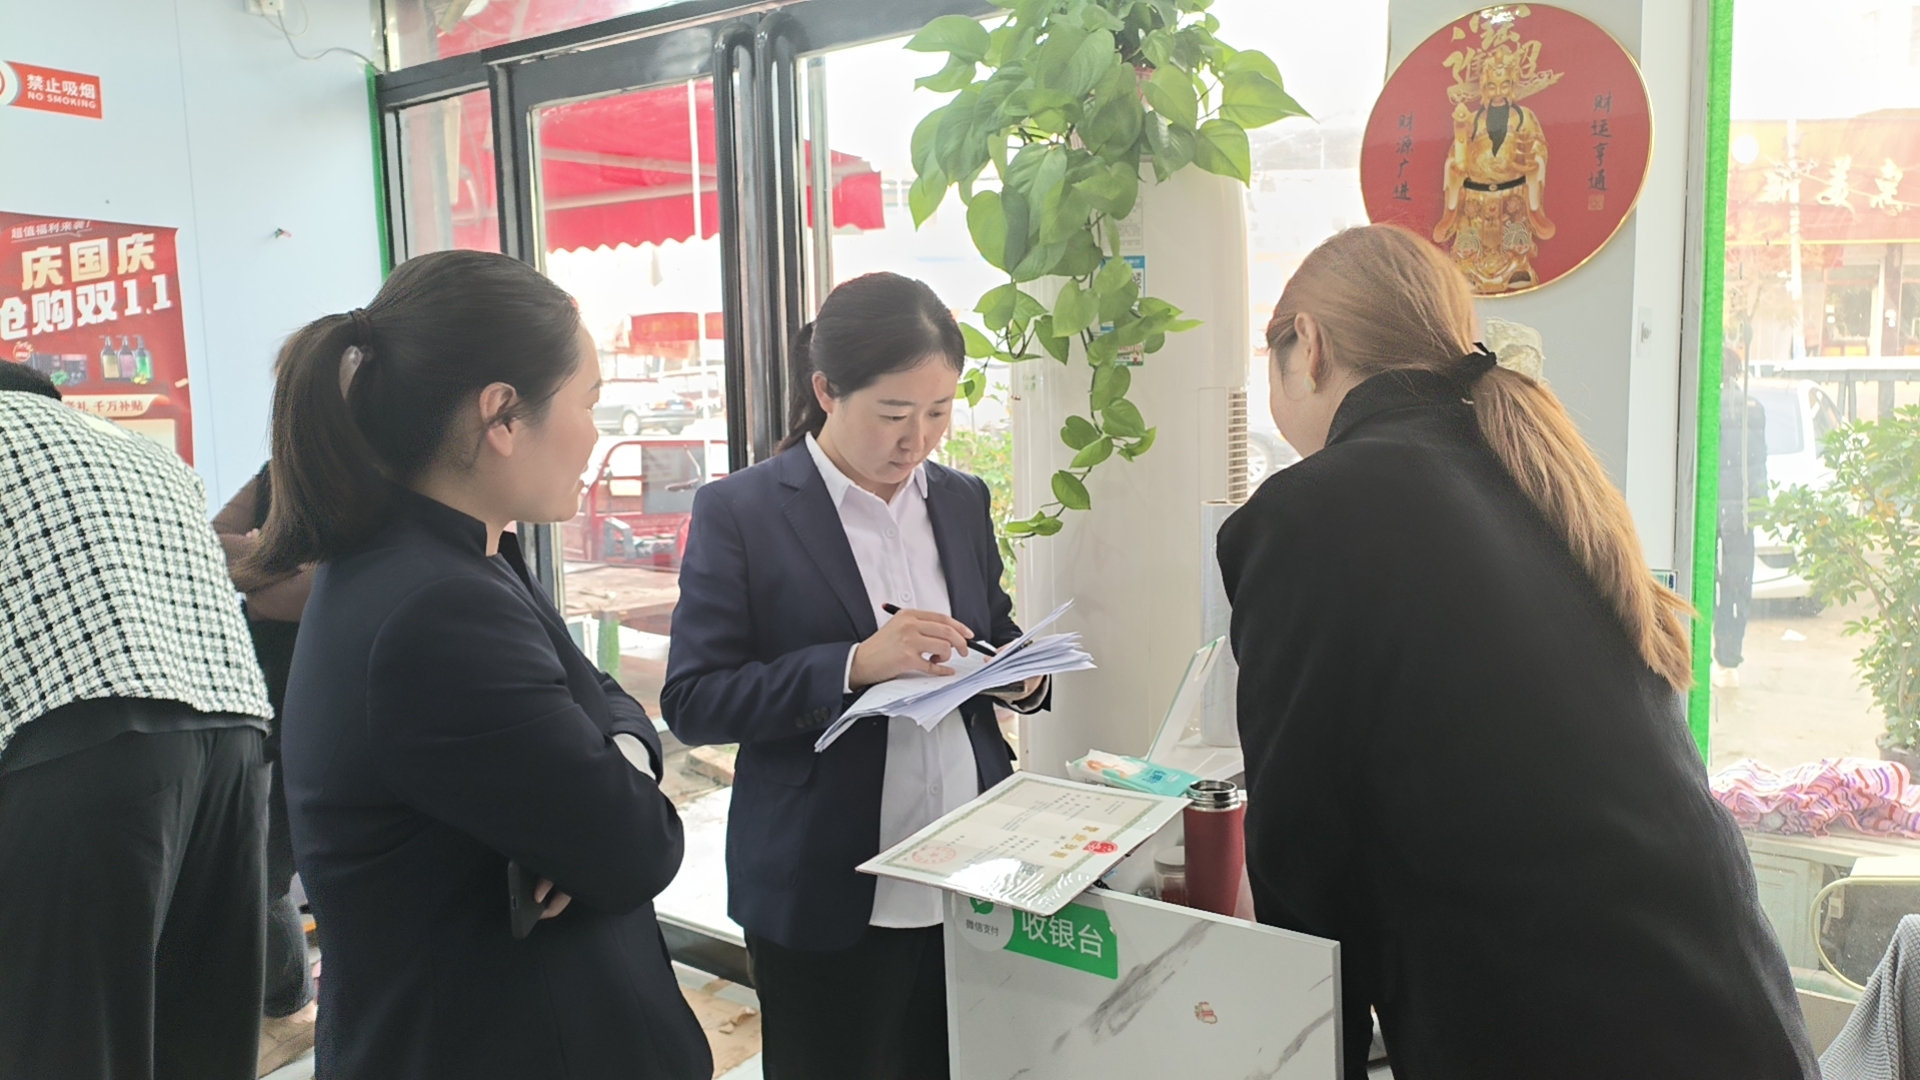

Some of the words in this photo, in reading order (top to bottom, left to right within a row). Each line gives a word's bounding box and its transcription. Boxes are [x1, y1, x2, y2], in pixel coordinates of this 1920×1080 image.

[26, 74, 96, 100] 禁止吸烟
[27, 91, 45, 101] NO
[46, 94, 97, 109] SMOKING
[1588, 90, 1613, 192] 财运亨通
[21, 232, 156, 291] 庆国庆
[965, 918, 1000, 938] 微信支付
[1022, 911, 1104, 958] 收银台
